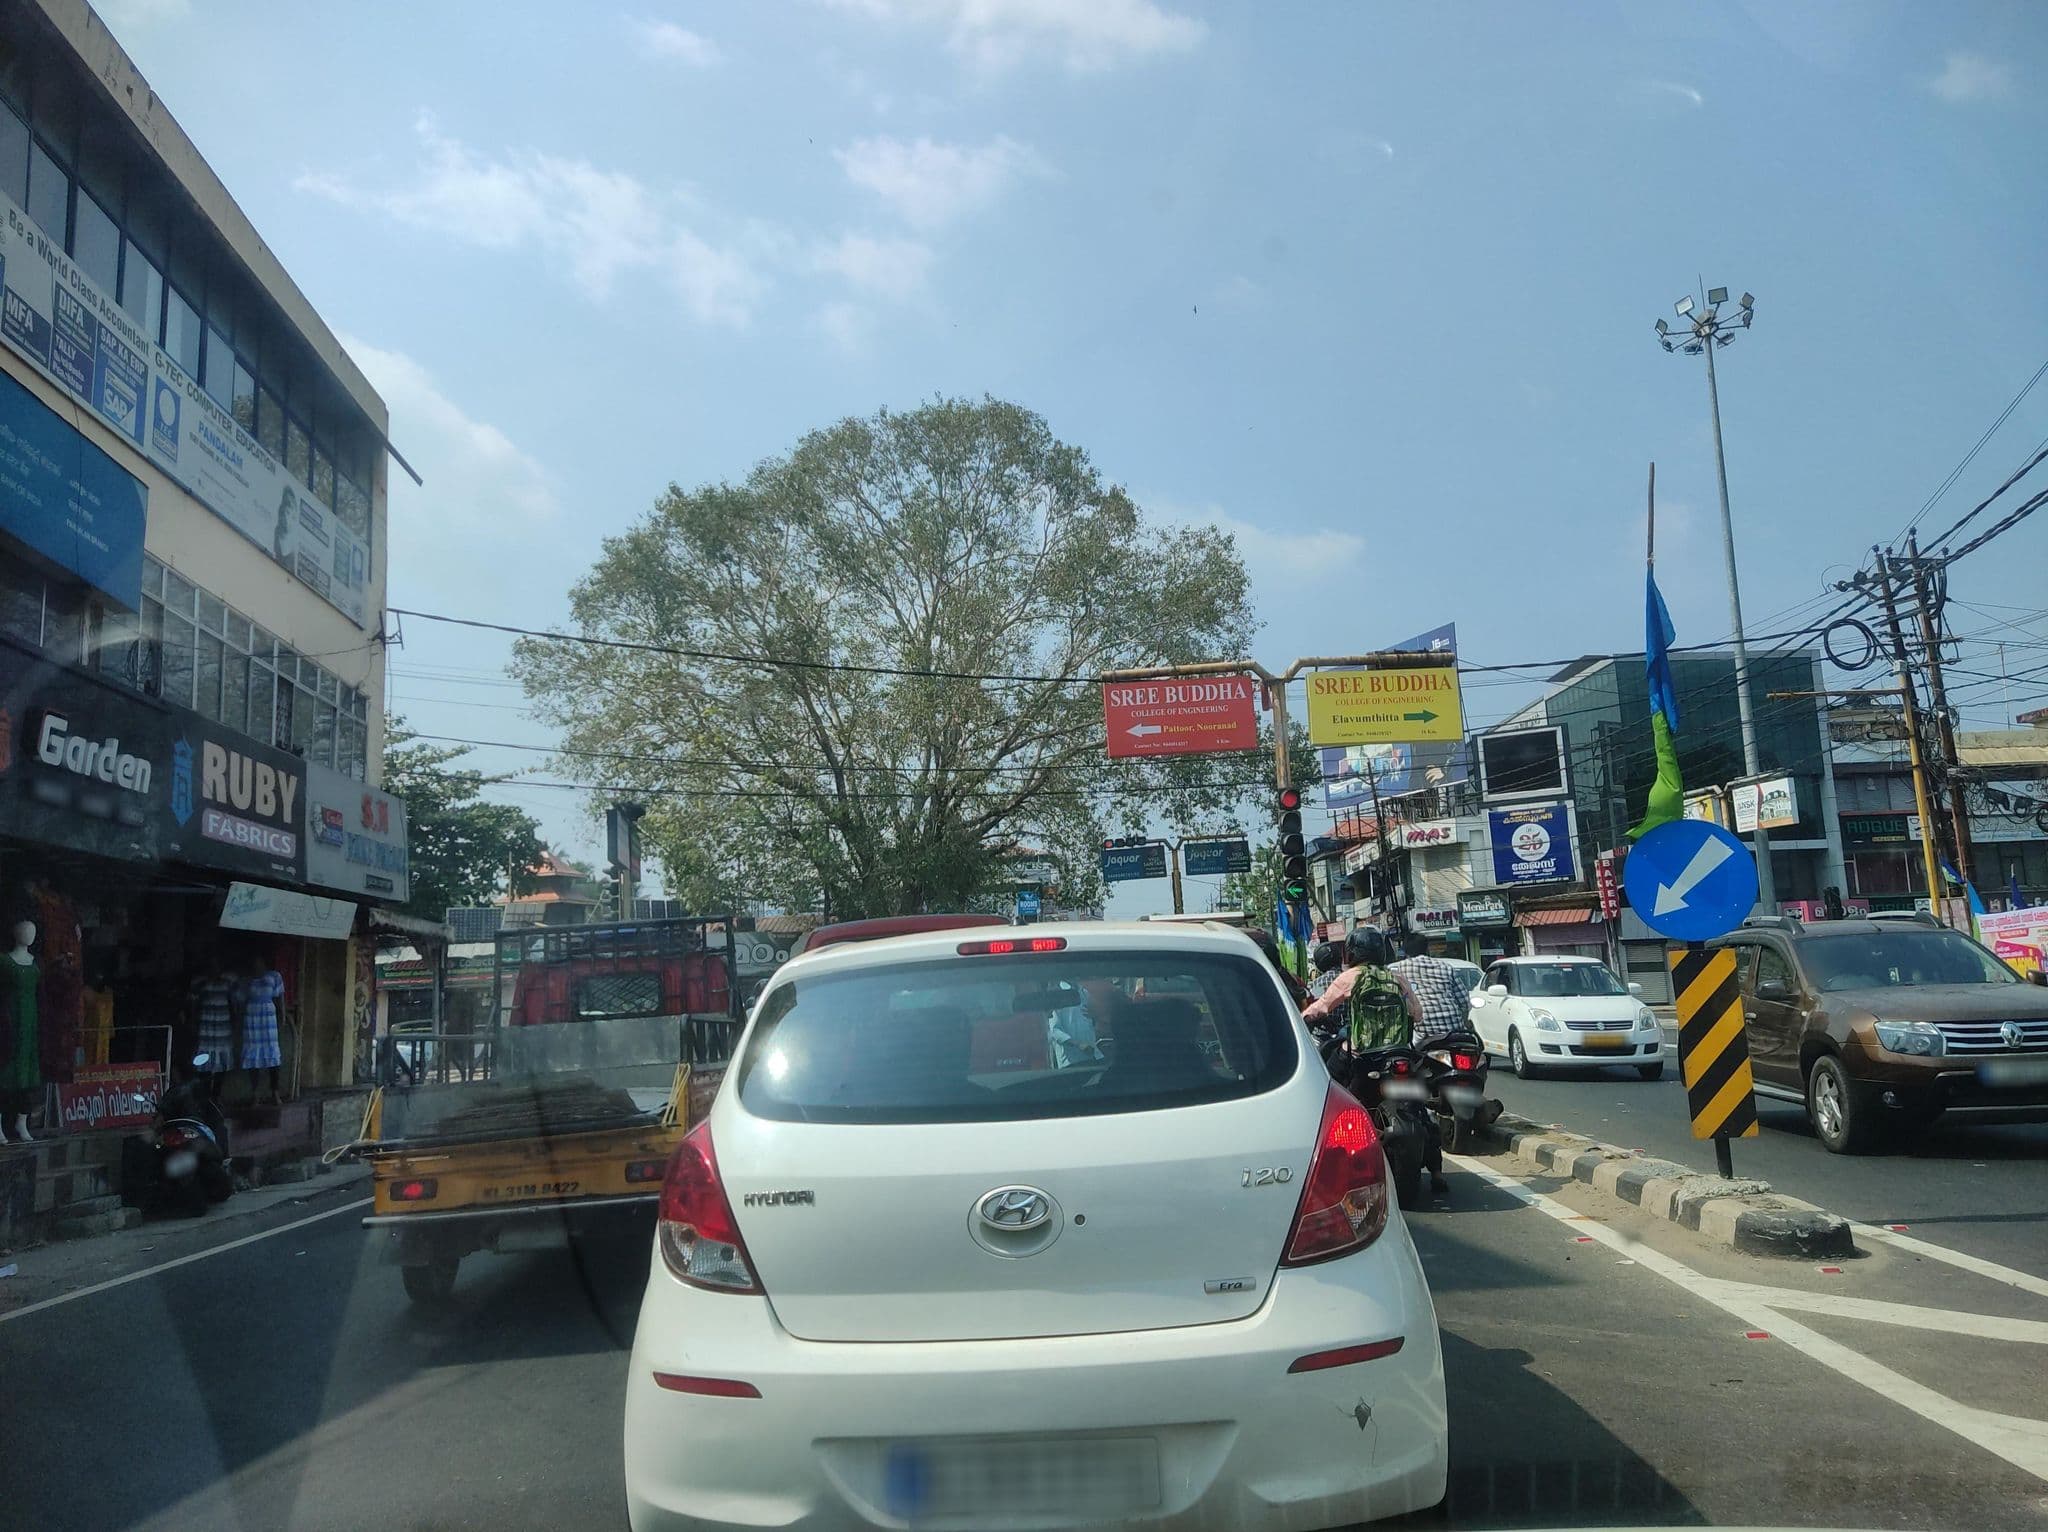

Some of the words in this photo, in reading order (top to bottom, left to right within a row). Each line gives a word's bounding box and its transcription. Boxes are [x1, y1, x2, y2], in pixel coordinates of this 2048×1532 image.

[9, 208, 24, 237] Be
[27, 231, 34, 247] a
[37, 235, 68, 281] World
[70, 269, 98, 309] Class
[99, 295, 150, 356] Accountant
[6, 291, 34, 334] MFA
[58, 289, 85, 329] DIFA
[55, 333, 77, 362] TALLY
[104, 387, 128, 420] SAP
[155, 351, 183, 388] G-TEC
[187, 381, 233, 435] COMPUTER
[235, 427, 277, 475] EDUCATION
[199, 420, 244, 470] PANDALAM
[1110, 686, 1160, 707] SREE
[1165, 682, 1247, 704] BUDDHA
[1314, 676, 1364, 695] SREE
[1370, 673, 1452, 693] BUDDHA
[1131, 708, 1167, 718] COLLEGE
[1167, 708, 1177, 716] OF
[1178, 704, 1229, 715] ENGINEERING
[1335, 698, 1371, 706] COLLEGE
[1382, 696, 1434, 704] ENGINEERING
[1332, 712, 1400, 725] Elavumthitta
[38, 714, 152, 794] Garden
[202, 739, 298, 825] RUBY
[208, 813, 292, 855] FABRICS
[1407, 827, 1451, 843] MAS
[1104, 854, 1141, 867] Jaquar
[1602, 859, 1618, 918] BAKERY
[1424, 919, 1451, 927] MOBILE
[744, 1190, 816, 1207] HYUNDAI
[1218, 1280, 1243, 1292] Era
